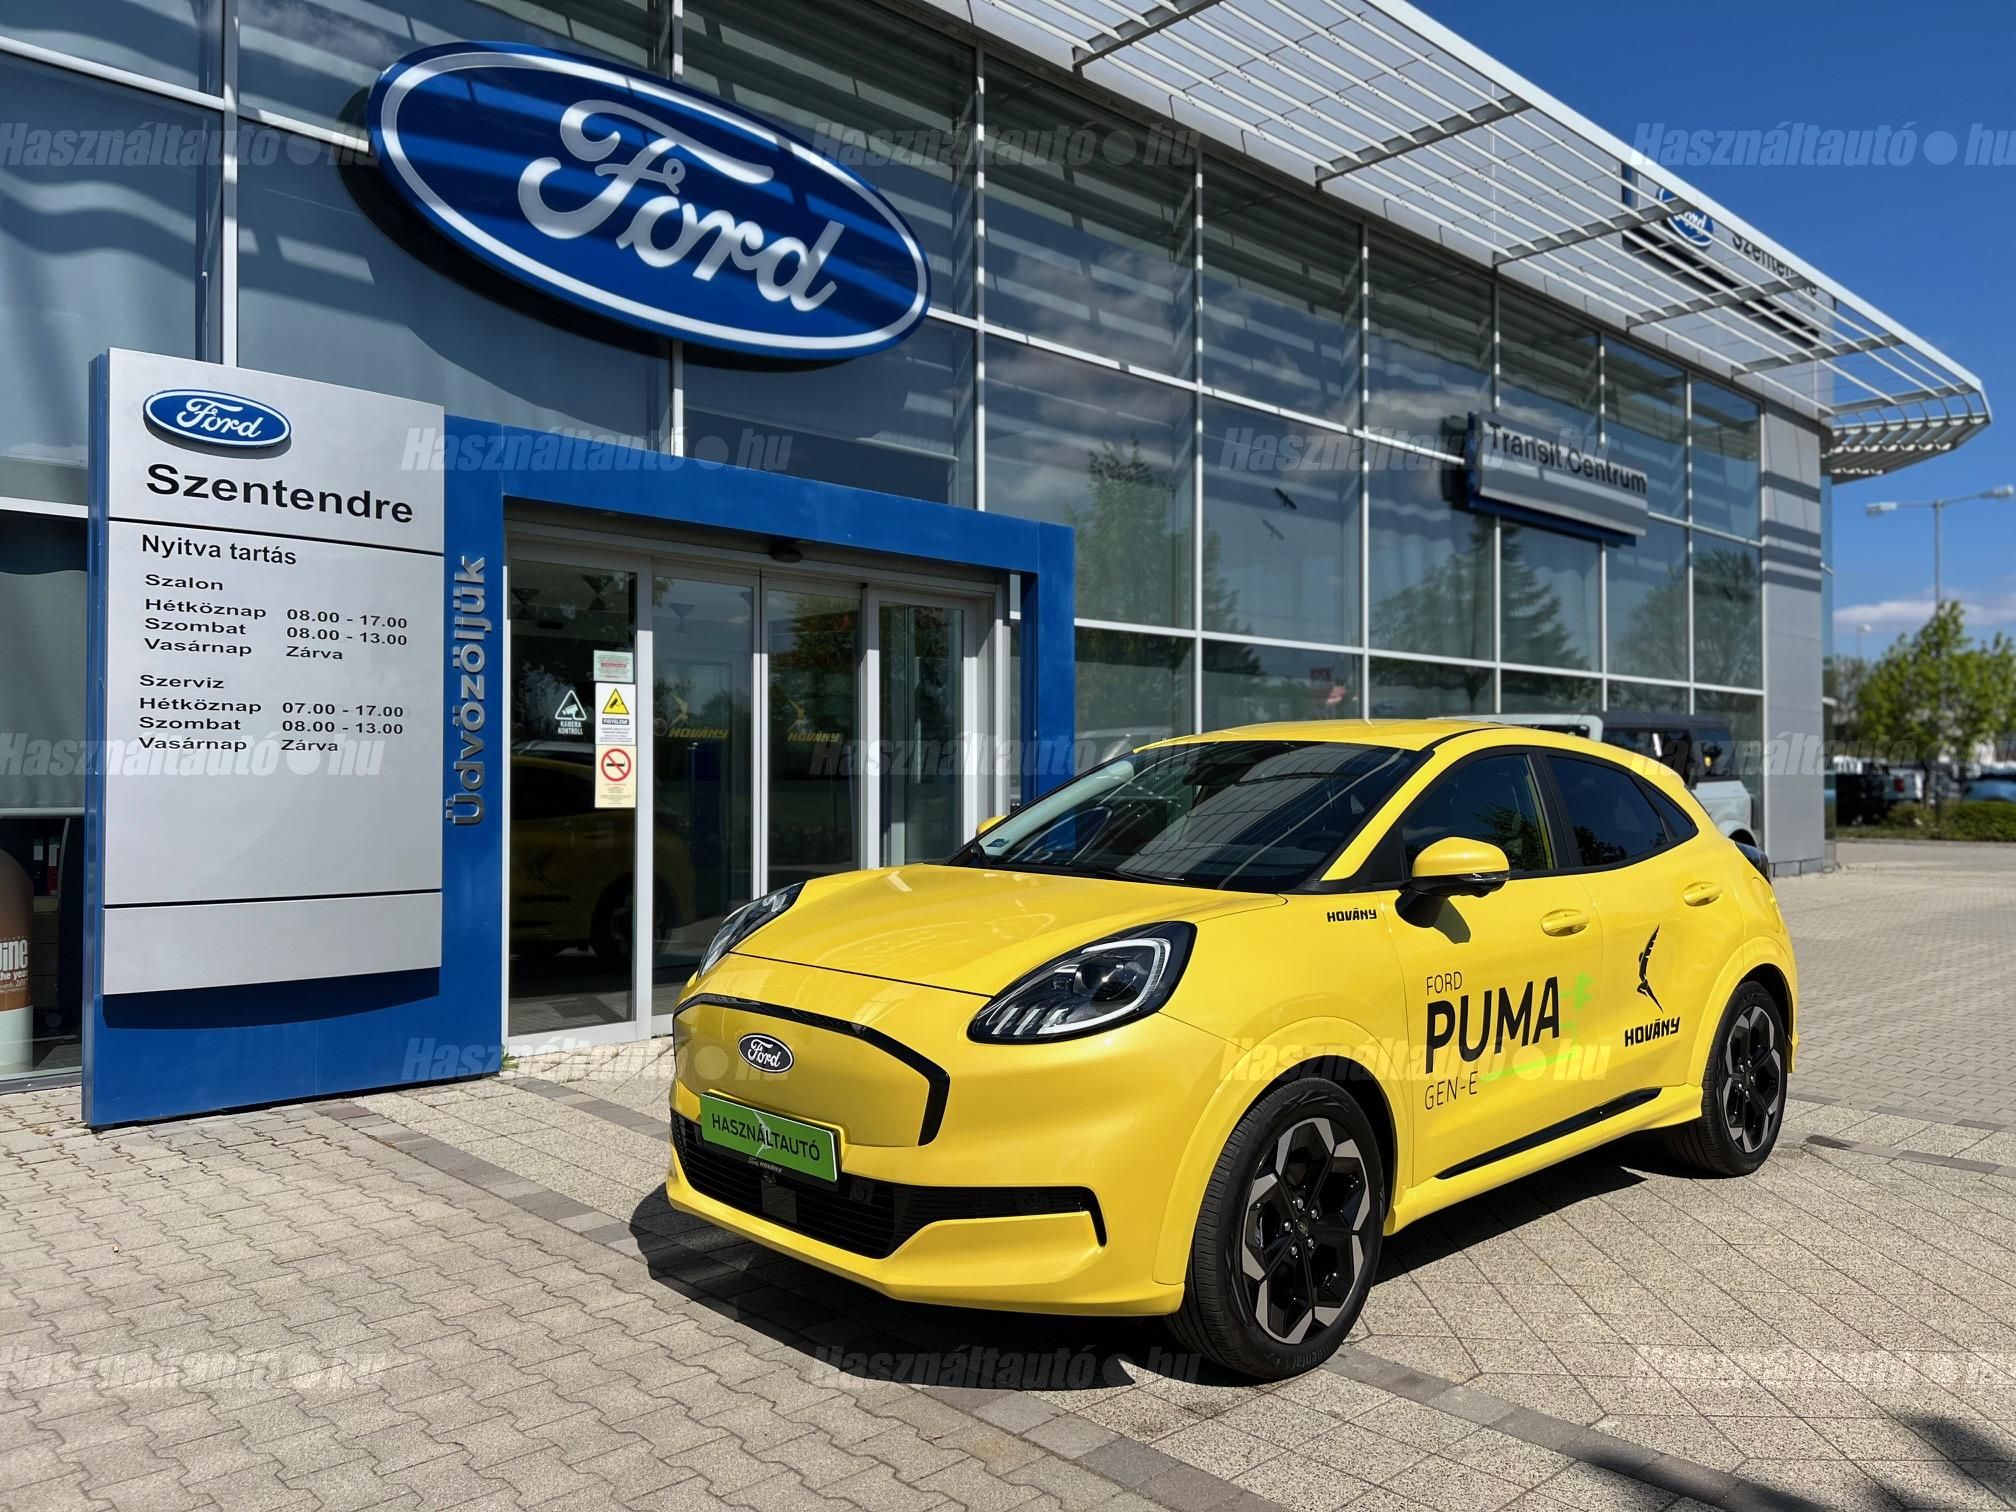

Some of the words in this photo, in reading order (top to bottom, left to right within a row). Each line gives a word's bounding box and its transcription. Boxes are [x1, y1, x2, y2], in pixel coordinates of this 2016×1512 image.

[518, 100, 845, 312] Ford
[176, 398, 264, 438] Ford
[1487, 421, 1561, 469] Transit
[1567, 449, 1646, 494] Centrum
[146, 463, 413, 523] Szentendre
[142, 534, 221, 559] Nyitva
[230, 542, 297, 565] tartás
[145, 574, 224, 591] Szalon
[145, 598, 267, 619] Hétköznap
[286, 608, 340, 623] 08.00
[359, 614, 408, 629] 17.00
[144, 617, 247, 635] Szombat
[286, 626, 340, 641] 08.00
[359, 631, 408, 646] 13.00
[144, 638, 253, 657] Vasárnap
[286, 645, 344, 660] Zárva
[139, 674, 225, 689] Szerviz
[446, 555, 492, 825] Üdvözöljük
[139, 697, 262, 714] Hétköznap
[282, 702, 336, 715] 07.00
[355, 705, 404, 718] 17.00
[139, 716, 241, 731] Szombat
[282, 720, 336, 733] 08.00
[355, 722, 404, 735] 13.00
[560, 720, 582, 728] KAMERA
[138, 736, 247, 752] Vasárnap
[281, 739, 339, 752] Zárva
[1426, 971, 1463, 996] FORD
[1425, 976, 1560, 1074] PUMA
[1424, 1071, 1478, 1110] GEN-E
[712, 1113, 821, 1161] HASZNÁLTAUTÓ
